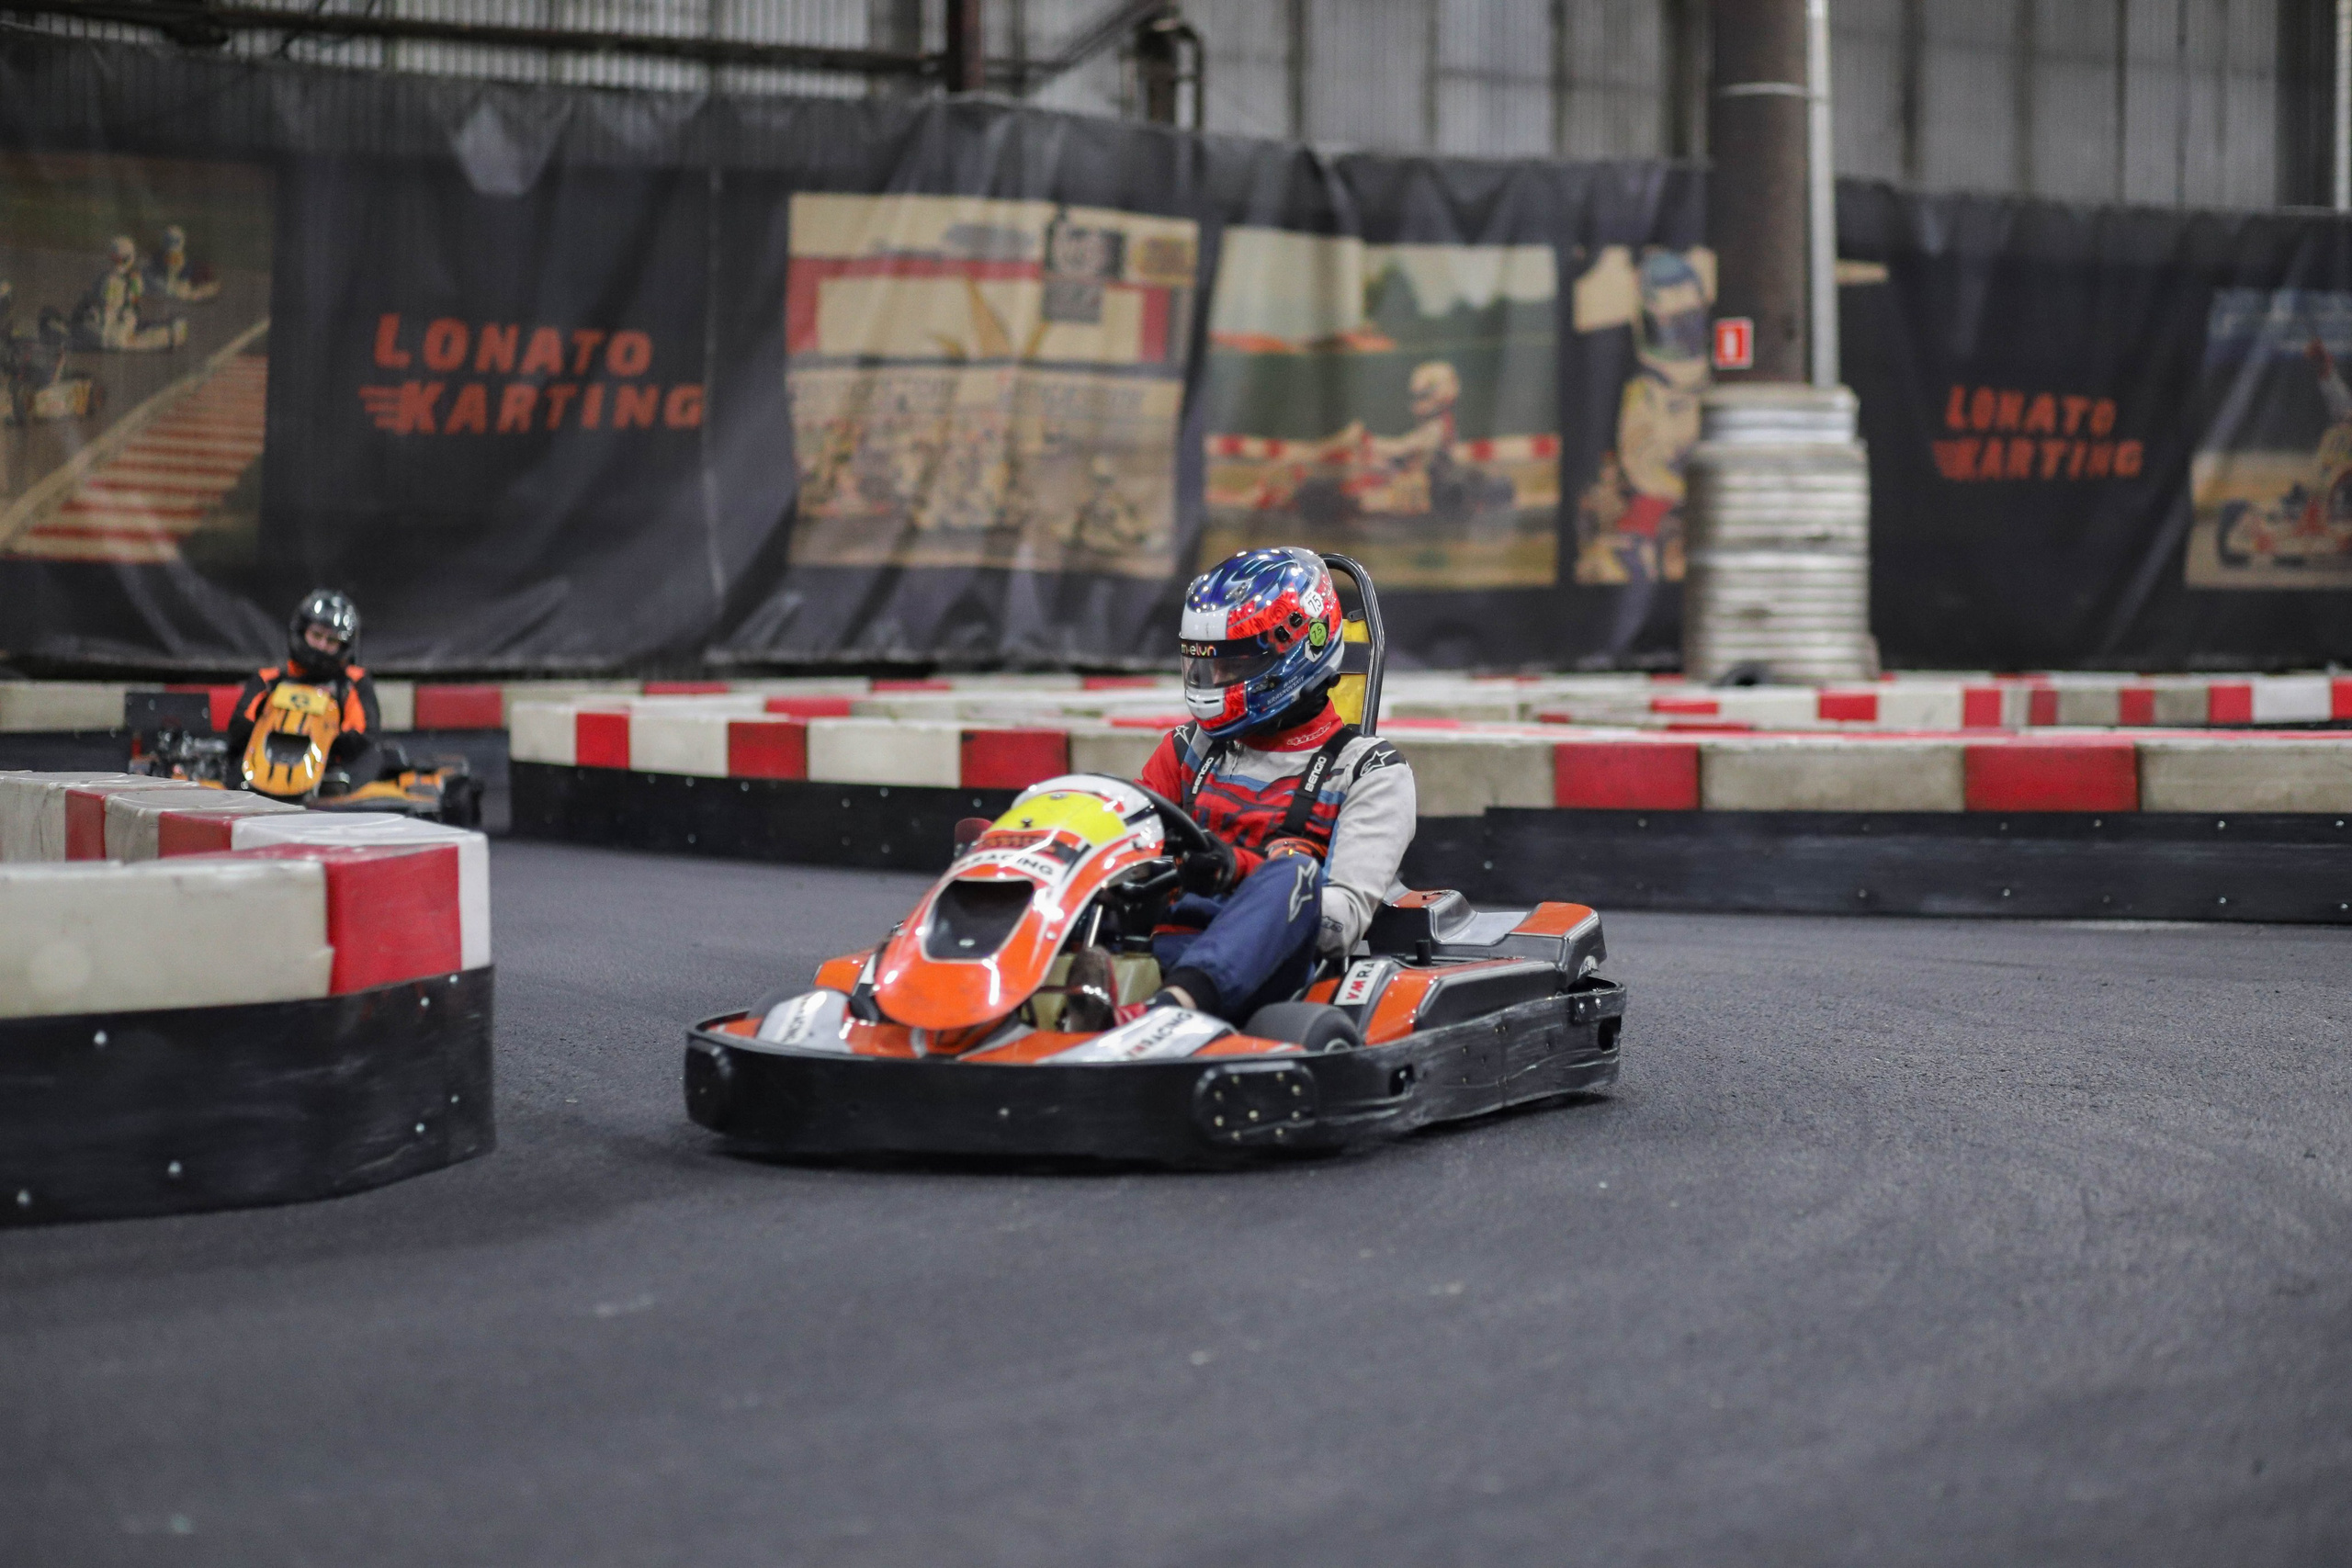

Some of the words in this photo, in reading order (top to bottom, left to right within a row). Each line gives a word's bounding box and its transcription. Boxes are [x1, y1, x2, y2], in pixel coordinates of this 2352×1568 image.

[373, 312, 653, 378] LONATO
[388, 380, 705, 435] KARTING
[1945, 384, 2118, 437] LONATO
[1940, 437, 2144, 481] KARTING
[1192, 756, 1215, 795] BENGIO
[1305, 756, 1328, 793] BENGIO
